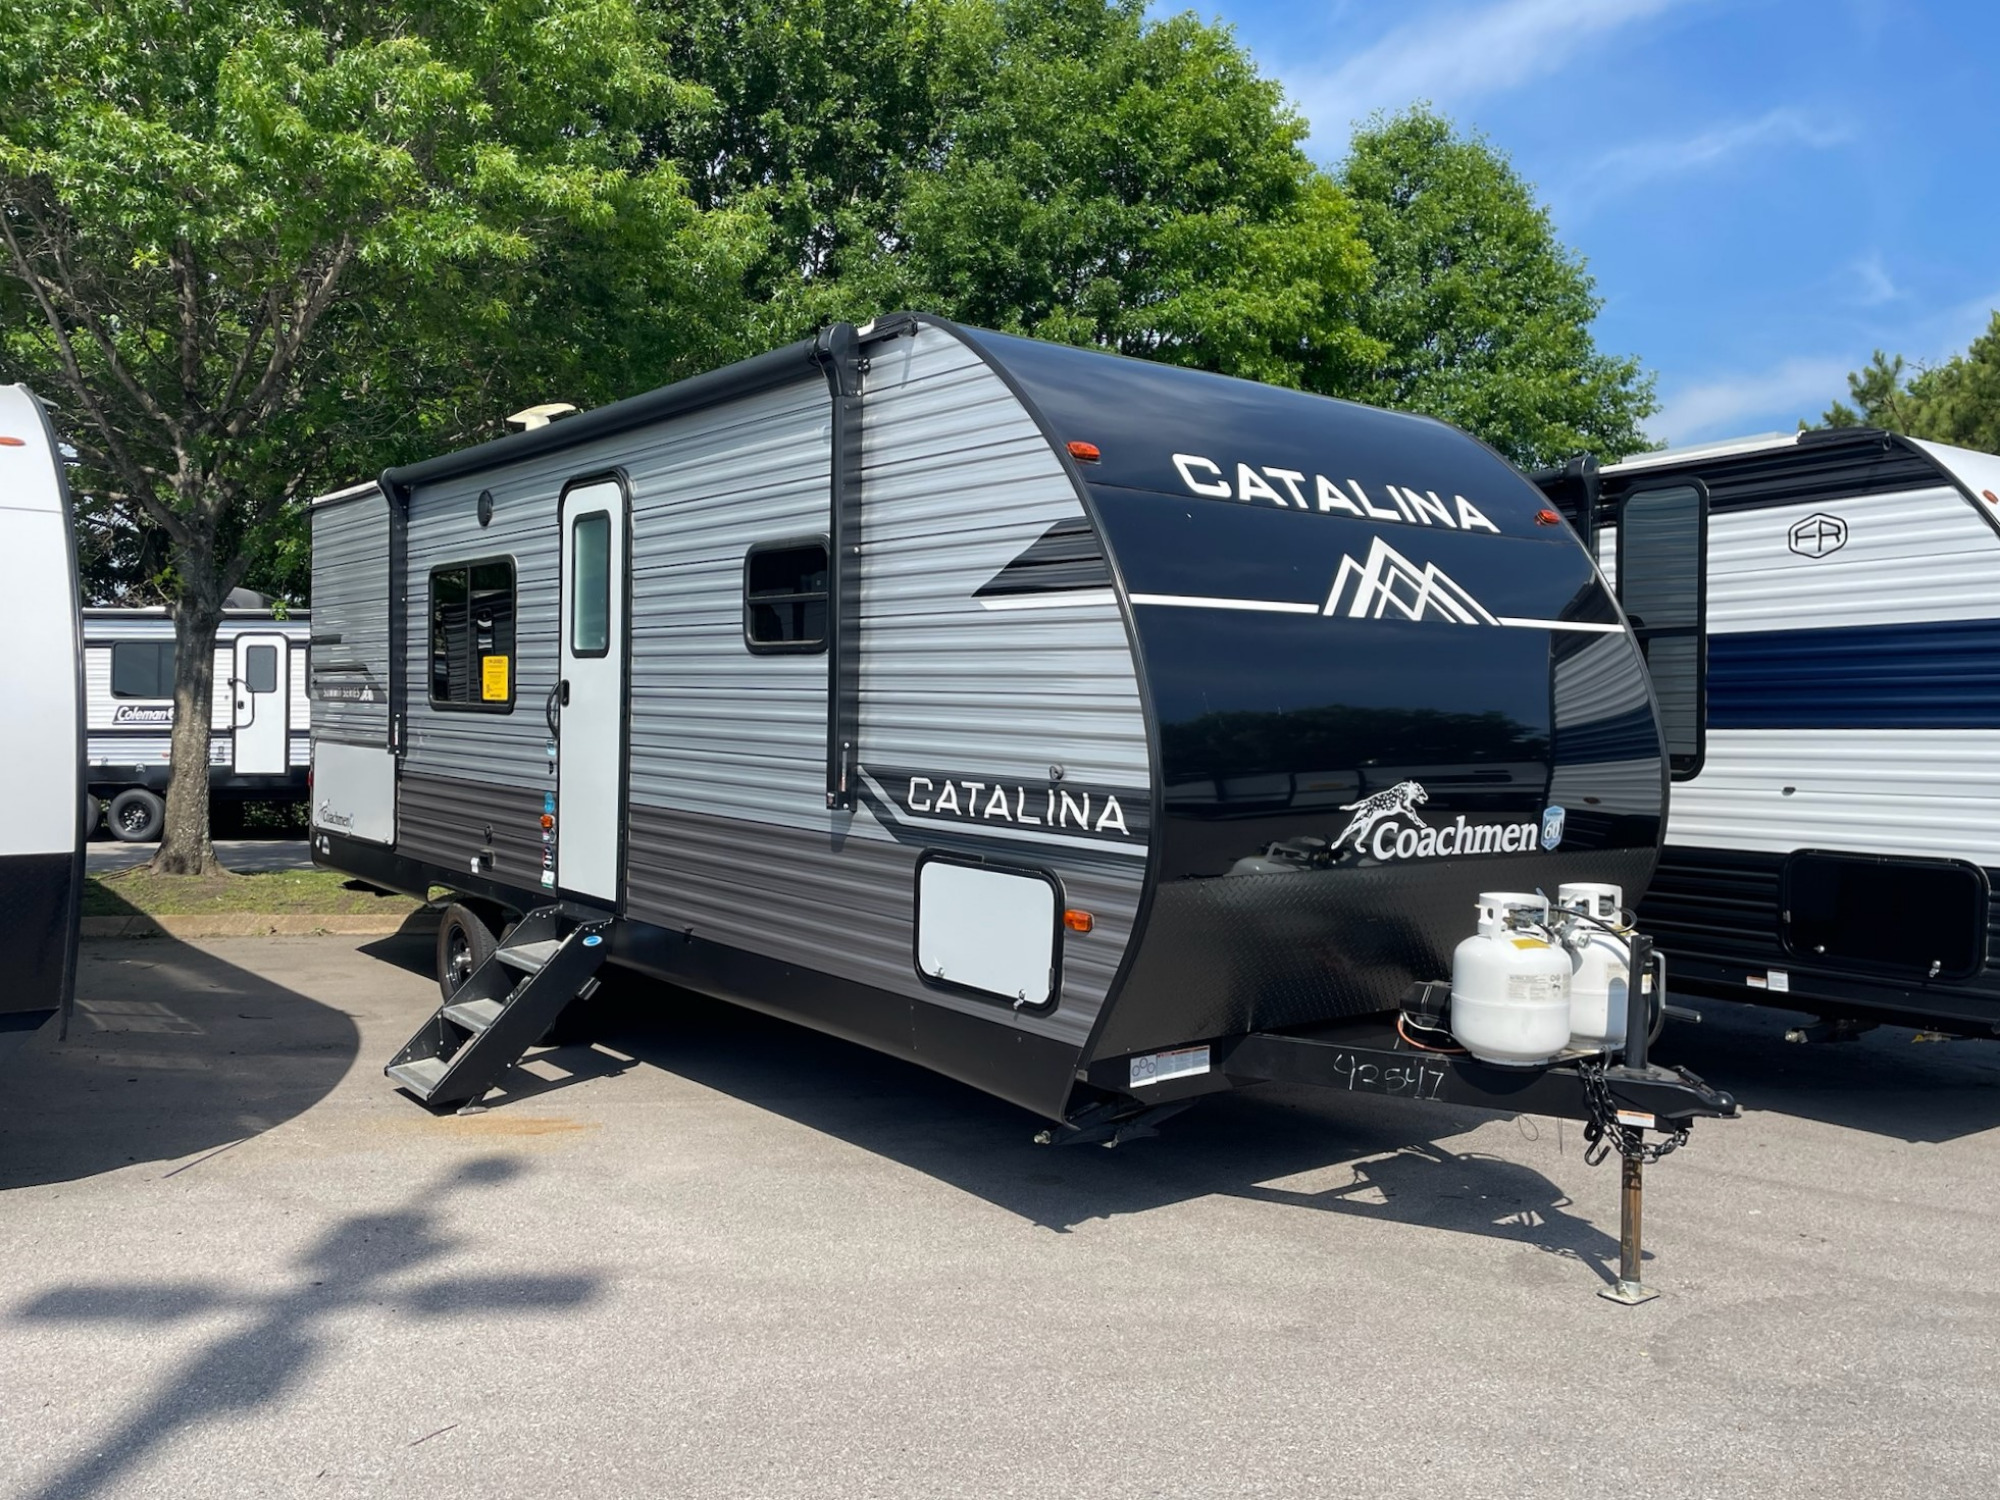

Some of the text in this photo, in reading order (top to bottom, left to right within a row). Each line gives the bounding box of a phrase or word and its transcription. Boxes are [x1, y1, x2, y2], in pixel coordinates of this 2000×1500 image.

[1172, 453, 1501, 533] CATALINA
[117, 706, 167, 721] Coleman
[907, 776, 1130, 836] CATALINA
[1373, 815, 1538, 861] Coachmen
